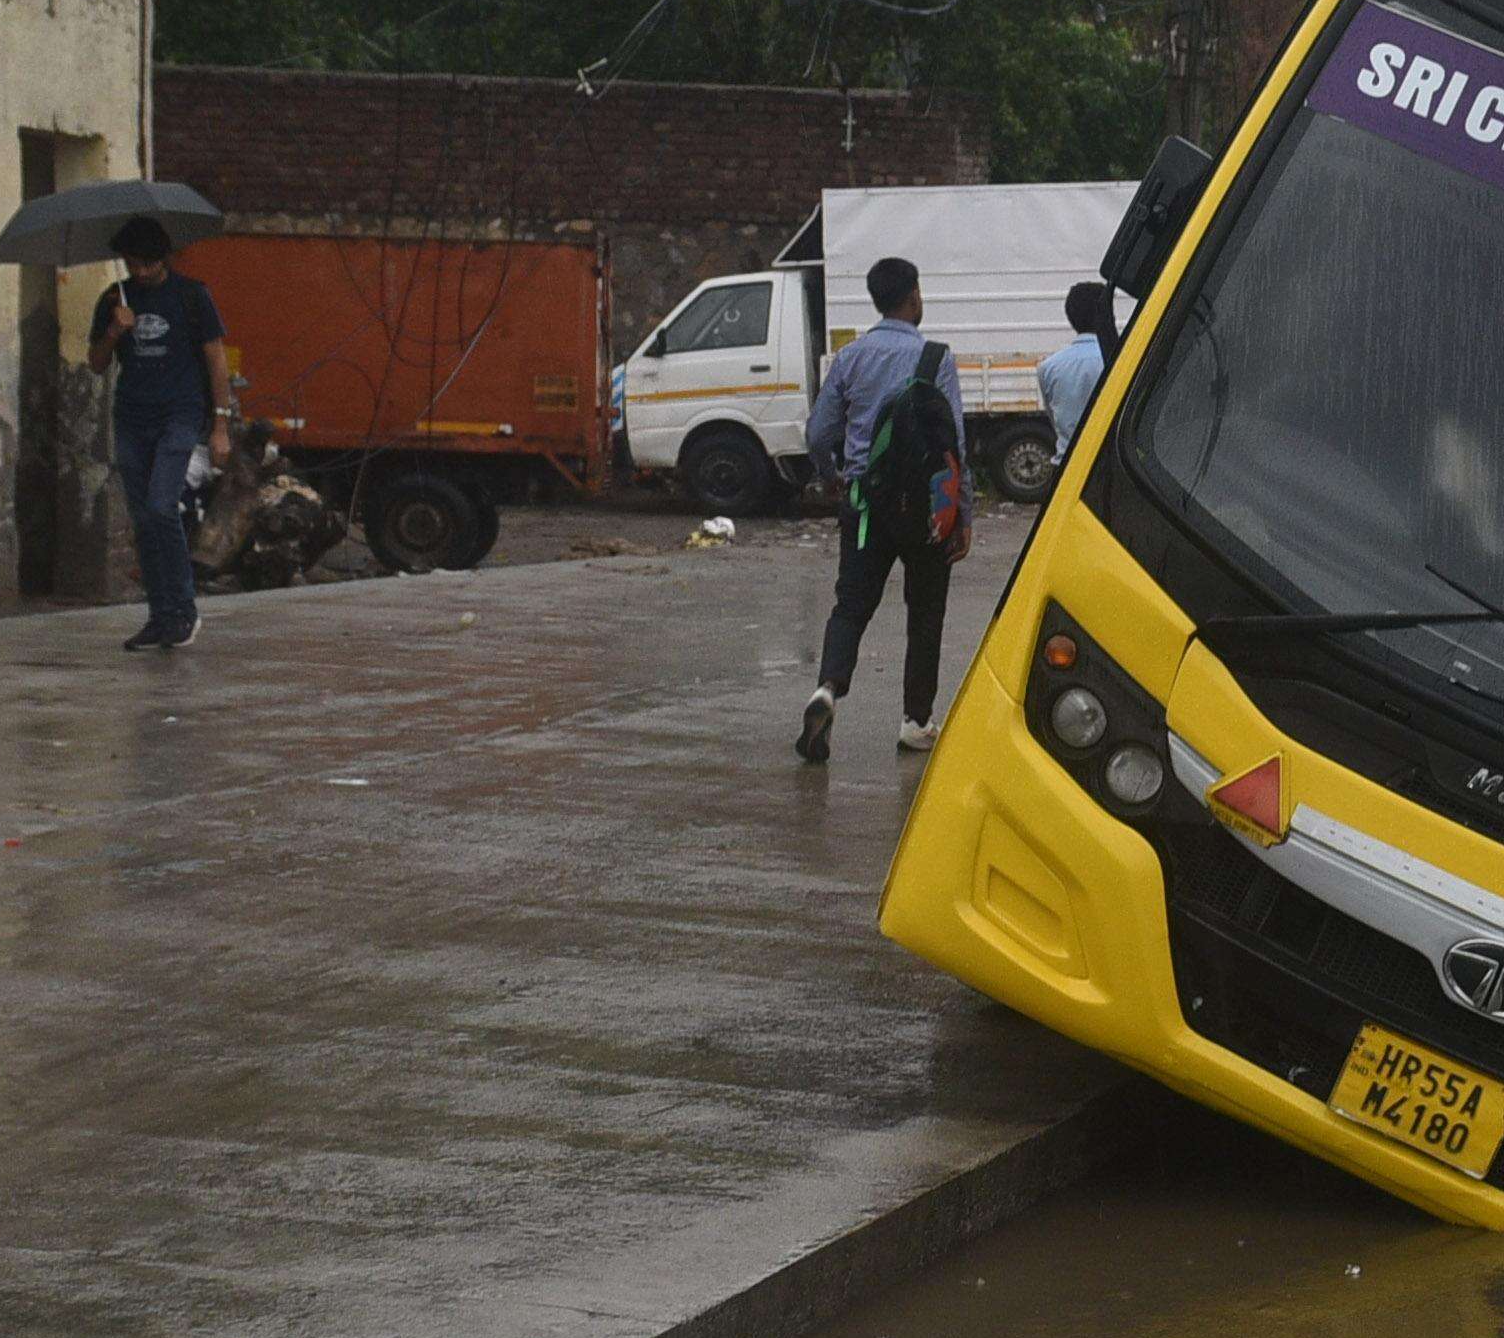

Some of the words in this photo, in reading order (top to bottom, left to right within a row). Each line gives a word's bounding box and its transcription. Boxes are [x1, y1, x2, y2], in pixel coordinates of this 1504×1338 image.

[1355, 42, 1470, 127] SRI
[1360, 1080, 1470, 1155] M4180
[1375, 1044, 1484, 1121] HR55A
